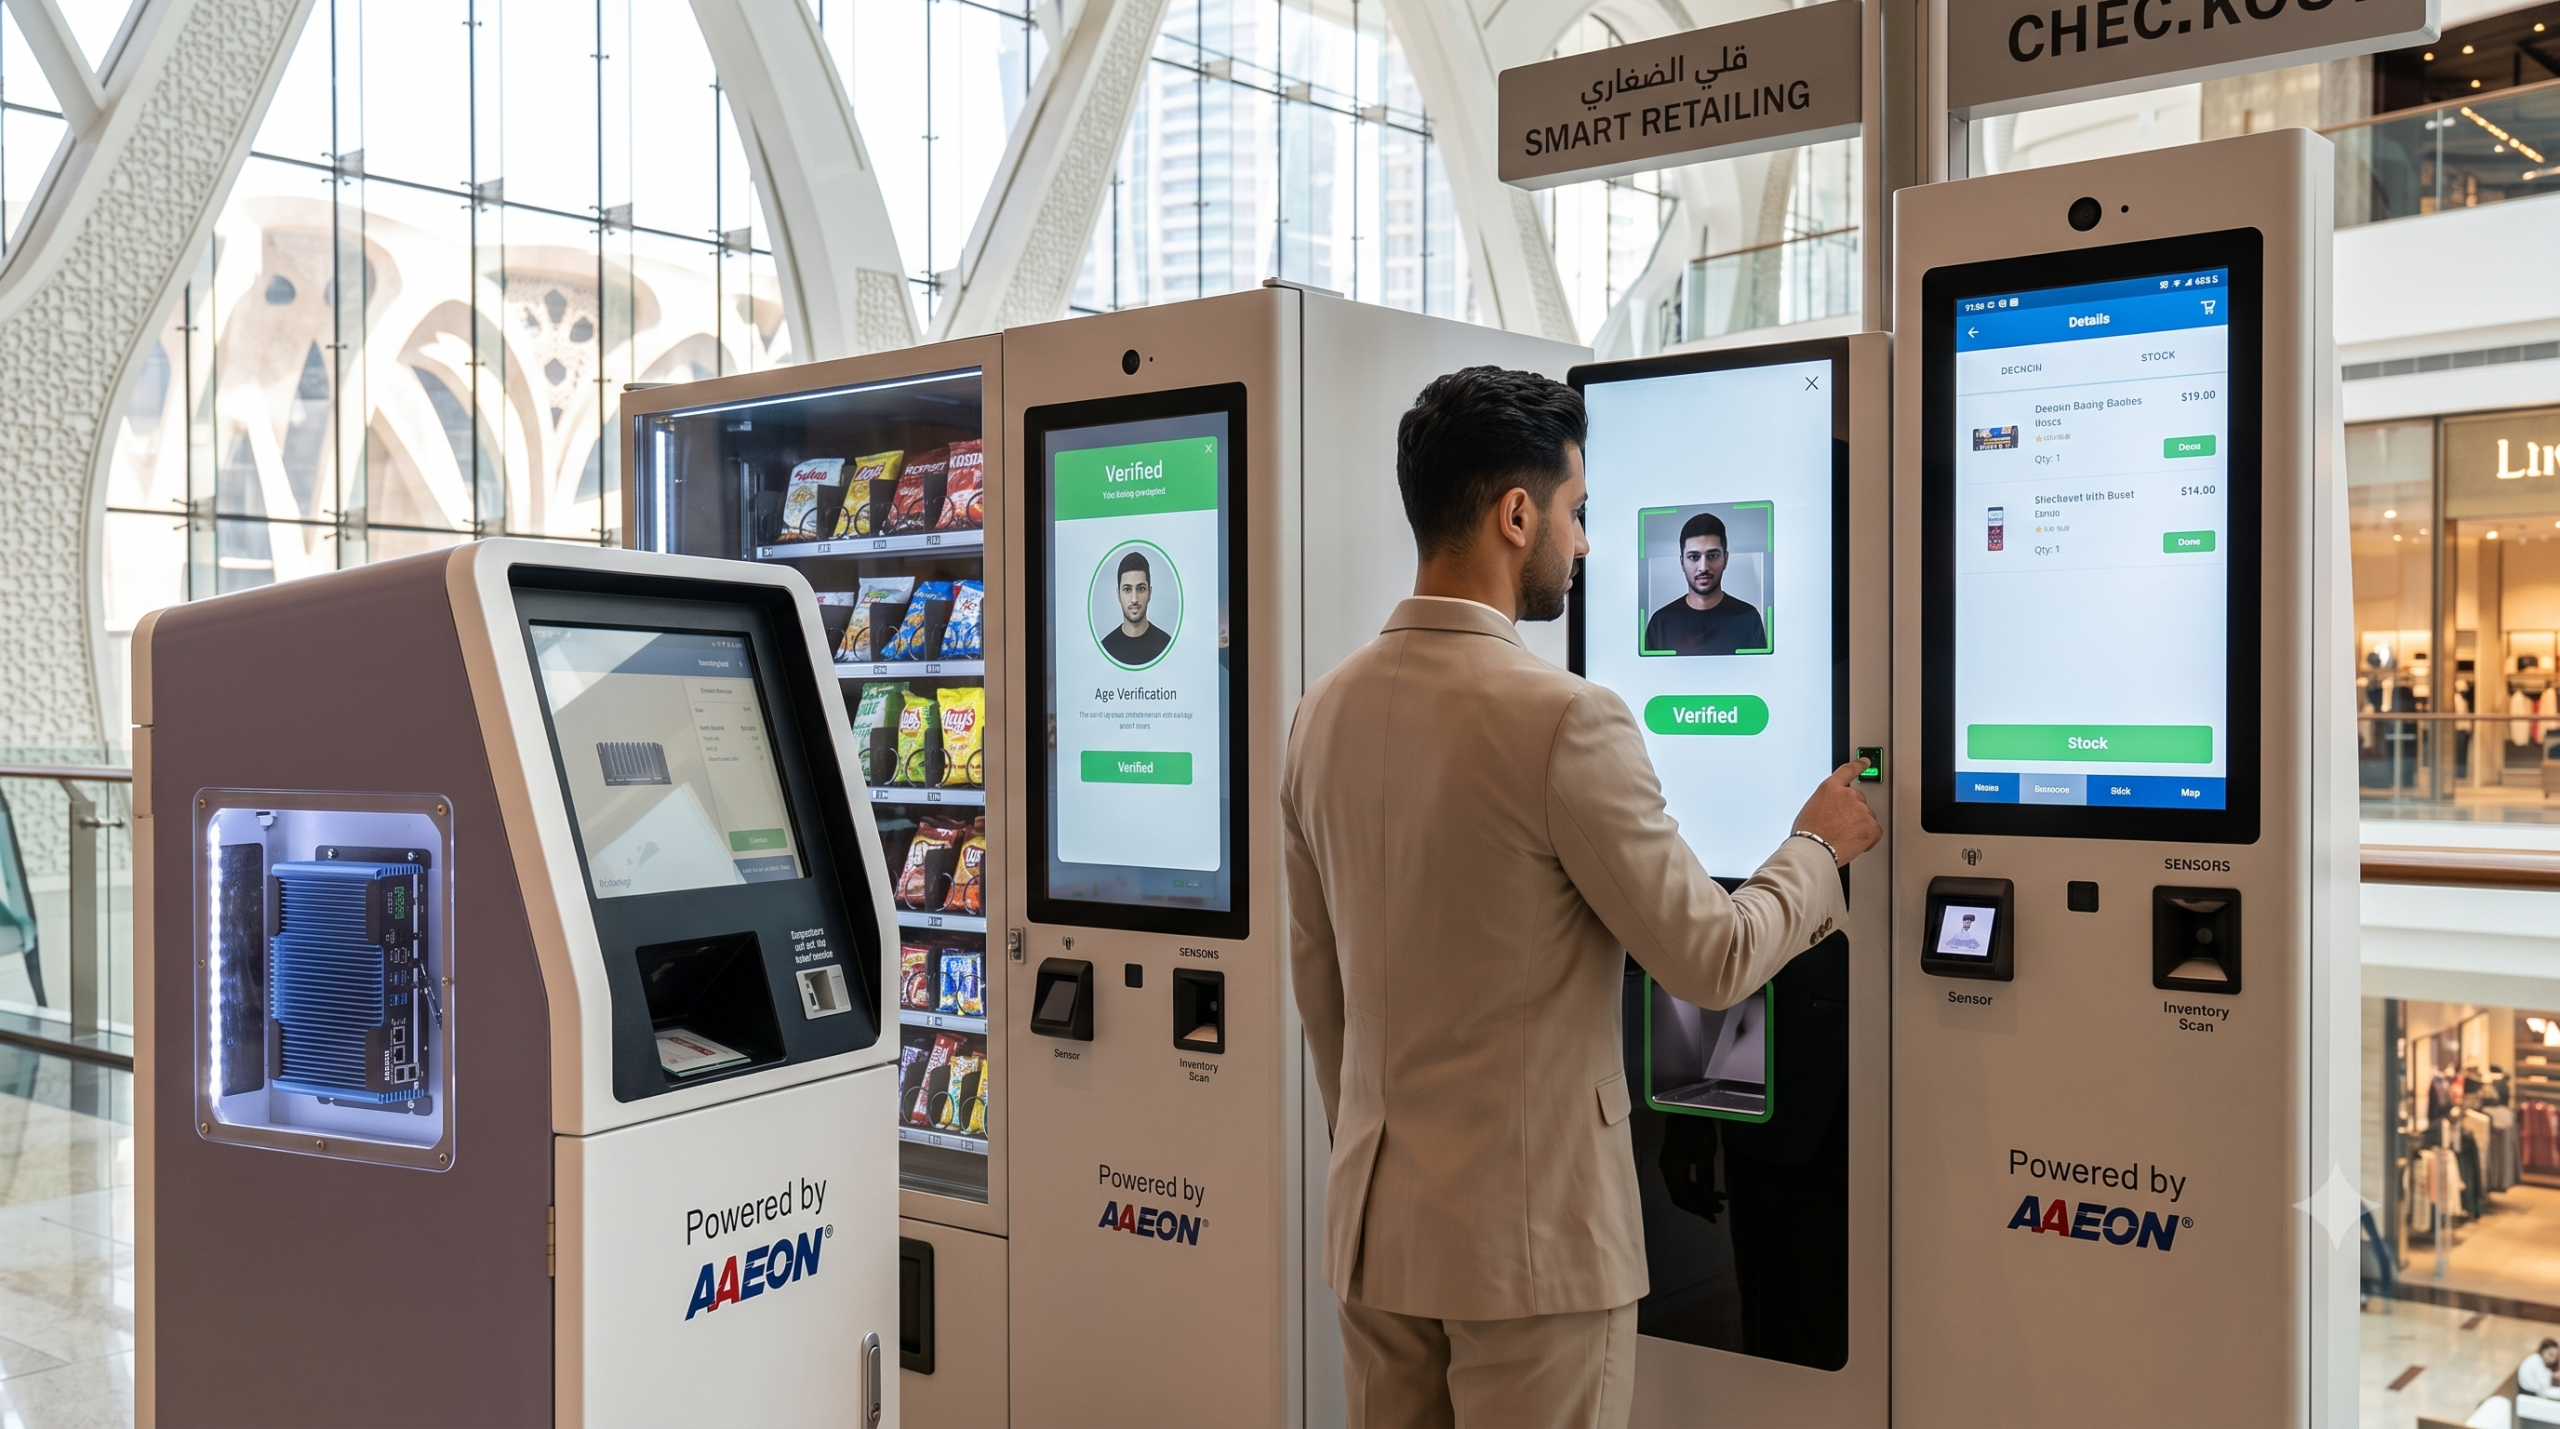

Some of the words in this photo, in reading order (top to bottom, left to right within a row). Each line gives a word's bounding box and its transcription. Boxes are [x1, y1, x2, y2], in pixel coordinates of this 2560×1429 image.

[1525, 111, 1632, 156] SMART
[1641, 79, 1811, 137] RETAILING
[2068, 313, 2111, 328] Details
[2141, 350, 2176, 362] STOCK
[2034, 455, 2053, 465] Qty:
[1105, 459, 1163, 483] Verified
[2178, 537, 2201, 547] Done
[2034, 545, 2053, 556] Qty:
[1094, 687, 1115, 703] Age
[1116, 686, 1177, 701] Verification
[1672, 706, 1738, 724] Verified
[2067, 736, 2109, 751] Stock
[1117, 760, 1154, 775] Verified
[2181, 788, 2201, 798] Map
[2164, 858, 2231, 872] SENSORS
[1948, 990, 1993, 1006] Sensor
[2163, 1001, 2230, 1021] Inventory
[2178, 1018, 2214, 1033] Scan
[1054, 1048, 1081, 1061] Sensor
[1179, 1058, 1219, 1075] Inventory
[1188, 1071, 1210, 1083] Scan
[2009, 1148, 2138, 1191] Powered
[2150, 1164, 2187, 1203] by
[1099, 1163, 1178, 1198] Powered
[1183, 1177, 1205, 1208] by
[686, 1180, 792, 1246] Powered
[801, 1177, 827, 1216] by
